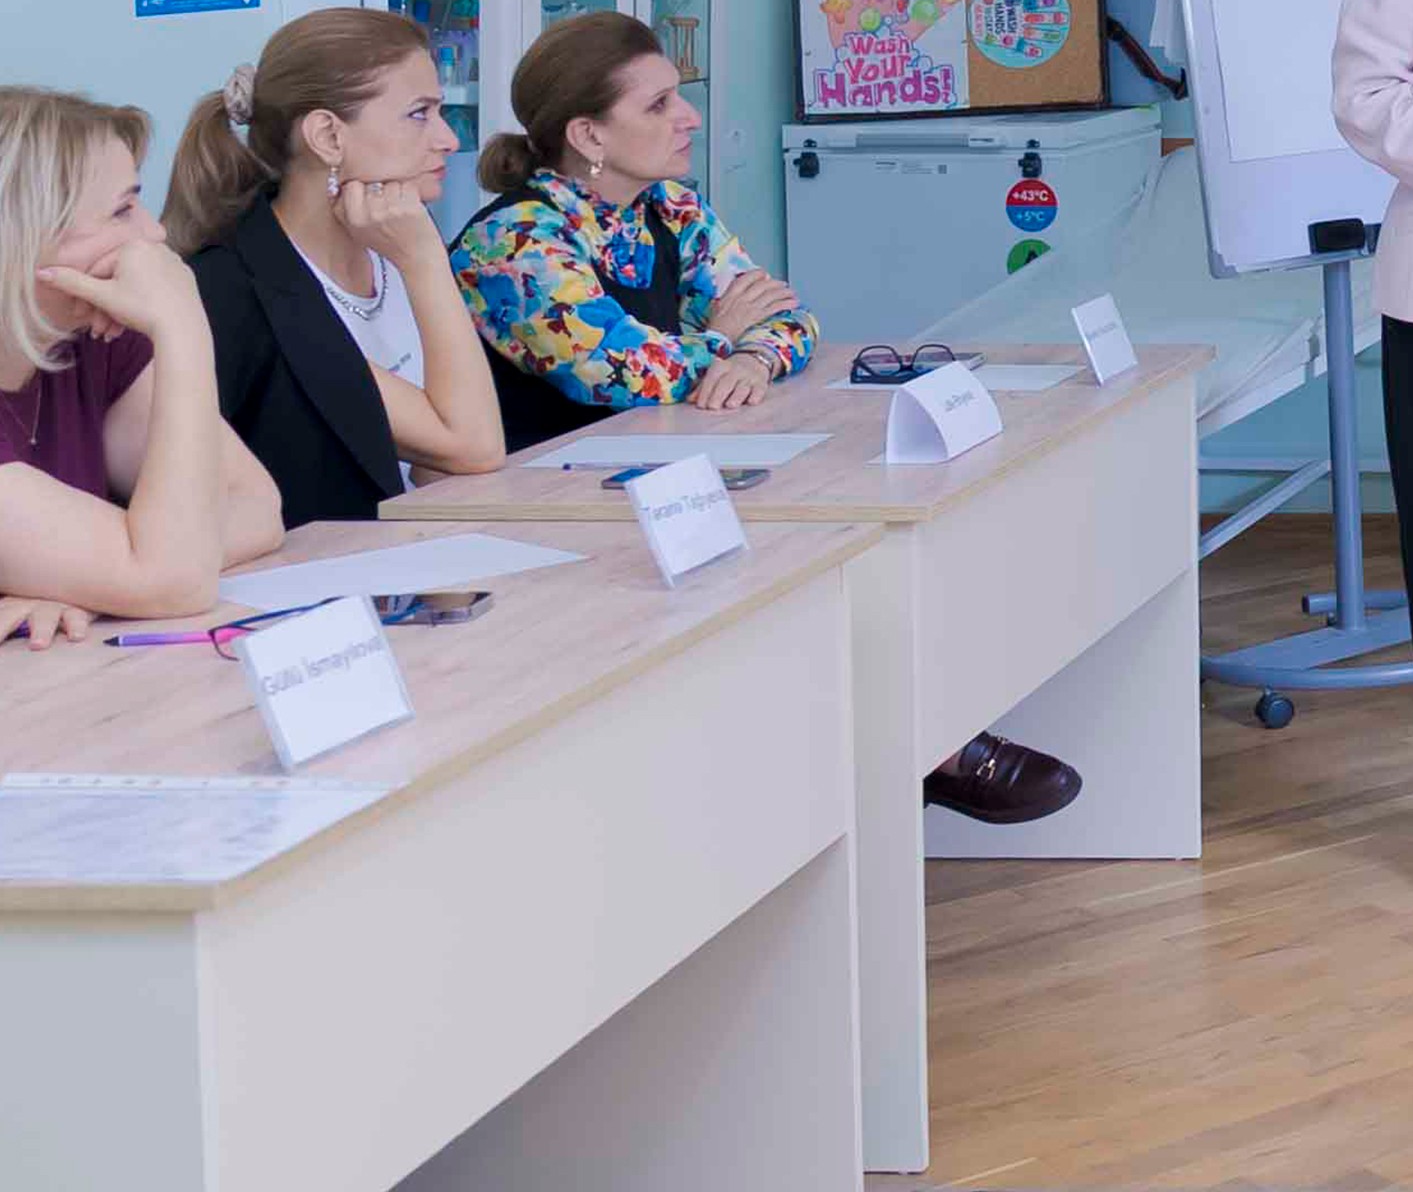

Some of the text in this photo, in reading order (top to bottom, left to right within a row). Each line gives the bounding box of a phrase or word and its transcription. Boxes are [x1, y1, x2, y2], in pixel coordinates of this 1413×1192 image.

[849, 35, 910, 55] Wash
[843, 55, 911, 84] Your
[819, 68, 952, 108] Hands!
